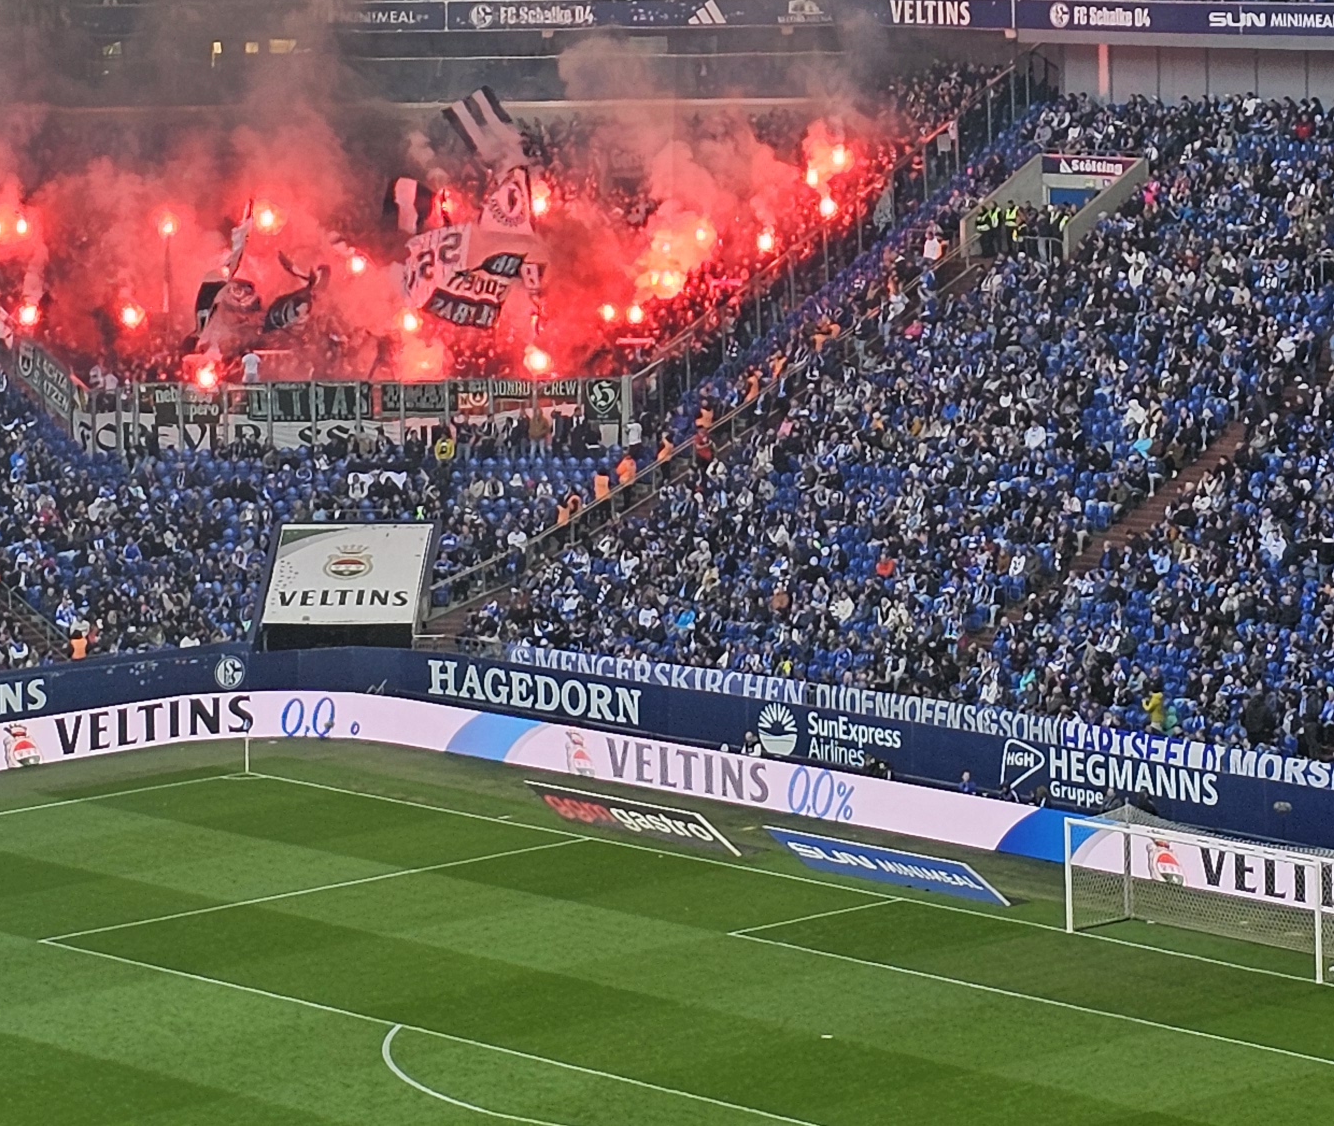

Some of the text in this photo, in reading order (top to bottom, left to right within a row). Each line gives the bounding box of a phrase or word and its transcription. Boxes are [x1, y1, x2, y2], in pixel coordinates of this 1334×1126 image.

[890, 0, 971, 26] VELTINS
[1074, 6, 1150, 27] FC Schalke 04
[1208, 12, 1266, 28] SUN
[1071, 158, 1123, 175] Stölting
[544, 381, 578, 396] CREW
[279, 589, 408, 607] VELTINS
[427, 659, 641, 725] HAGEDORN
[55, 695, 254, 755] VELTINS
[808, 711, 901, 749] SunExpress
[808, 740, 865, 766] Airlines
[1006, 751, 1035, 769] HGH
[606, 736, 770, 803] VELTINS
[1050, 747, 1219, 806] HEGMANNS
[1051, 781, 1104, 808] Gruppe
[609, 807, 714, 841] gastro
[787, 841, 984, 891] SUN MINIMEAL
